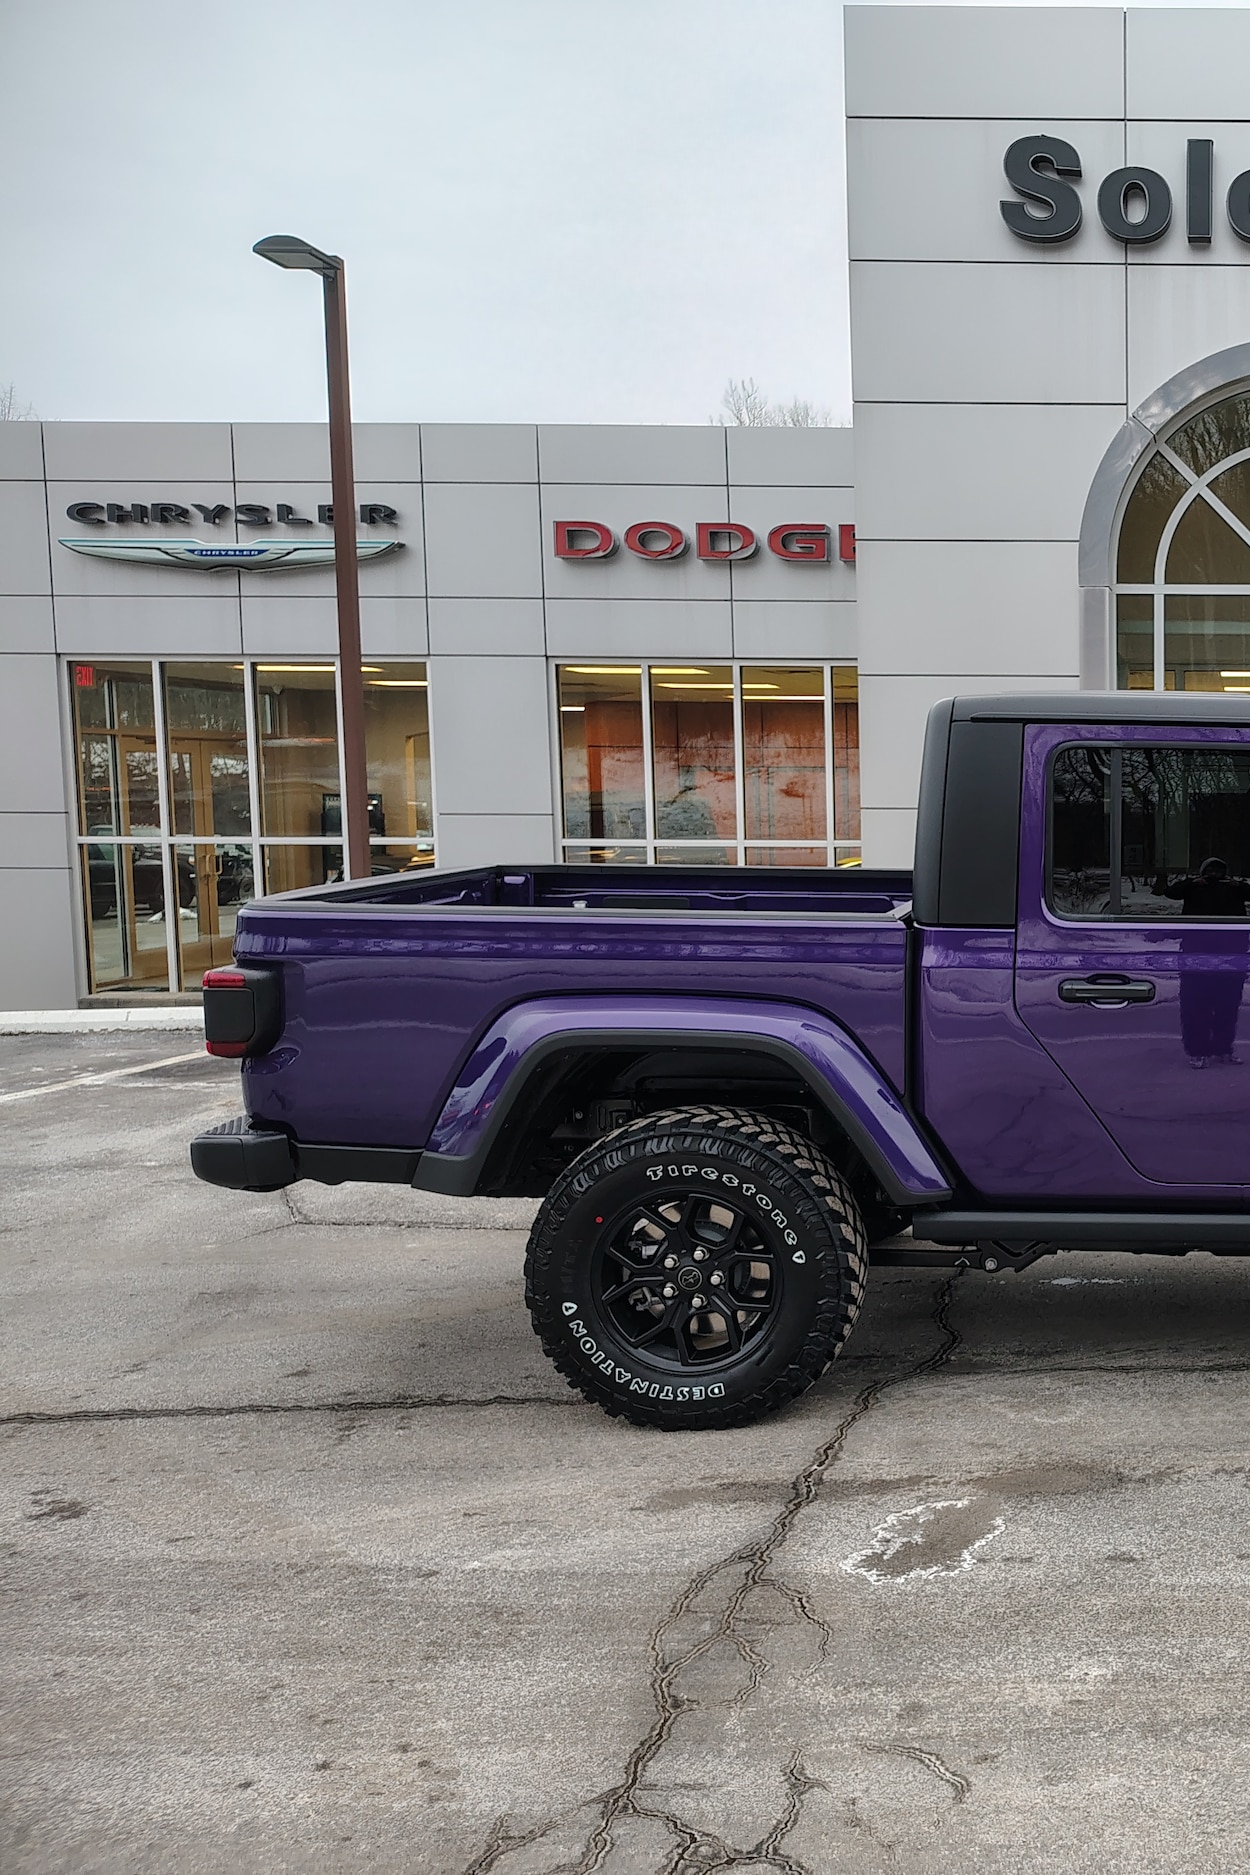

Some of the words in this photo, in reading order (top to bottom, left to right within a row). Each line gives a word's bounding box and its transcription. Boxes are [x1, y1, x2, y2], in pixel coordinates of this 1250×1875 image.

[75, 665, 94, 687] EXIT
[646, 1164, 798, 1246] Firestone
[568, 1319, 726, 1401] DESTINATION
